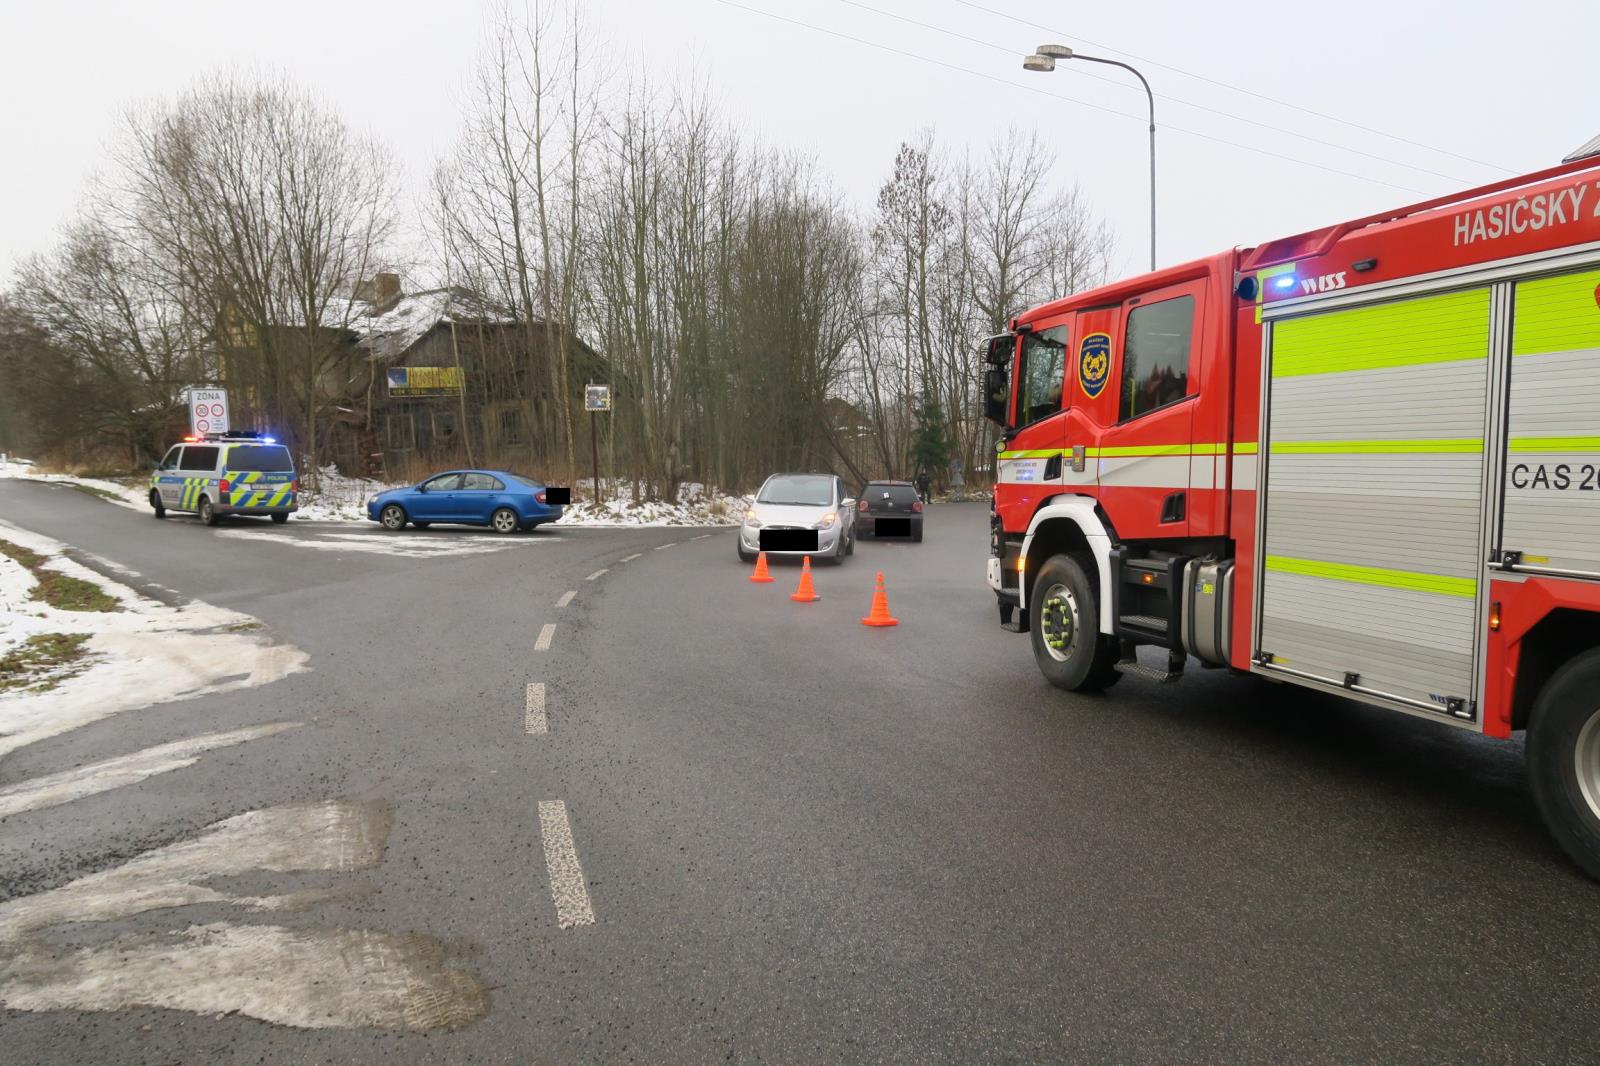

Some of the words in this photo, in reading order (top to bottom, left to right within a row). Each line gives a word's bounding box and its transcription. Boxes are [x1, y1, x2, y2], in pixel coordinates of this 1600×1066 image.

[1454, 181, 1587, 247] HASIČSKÝ
[1301, 271, 1347, 295] WISS
[1512, 464, 1571, 490] CAS
[1579, 464, 1600, 490] 2
